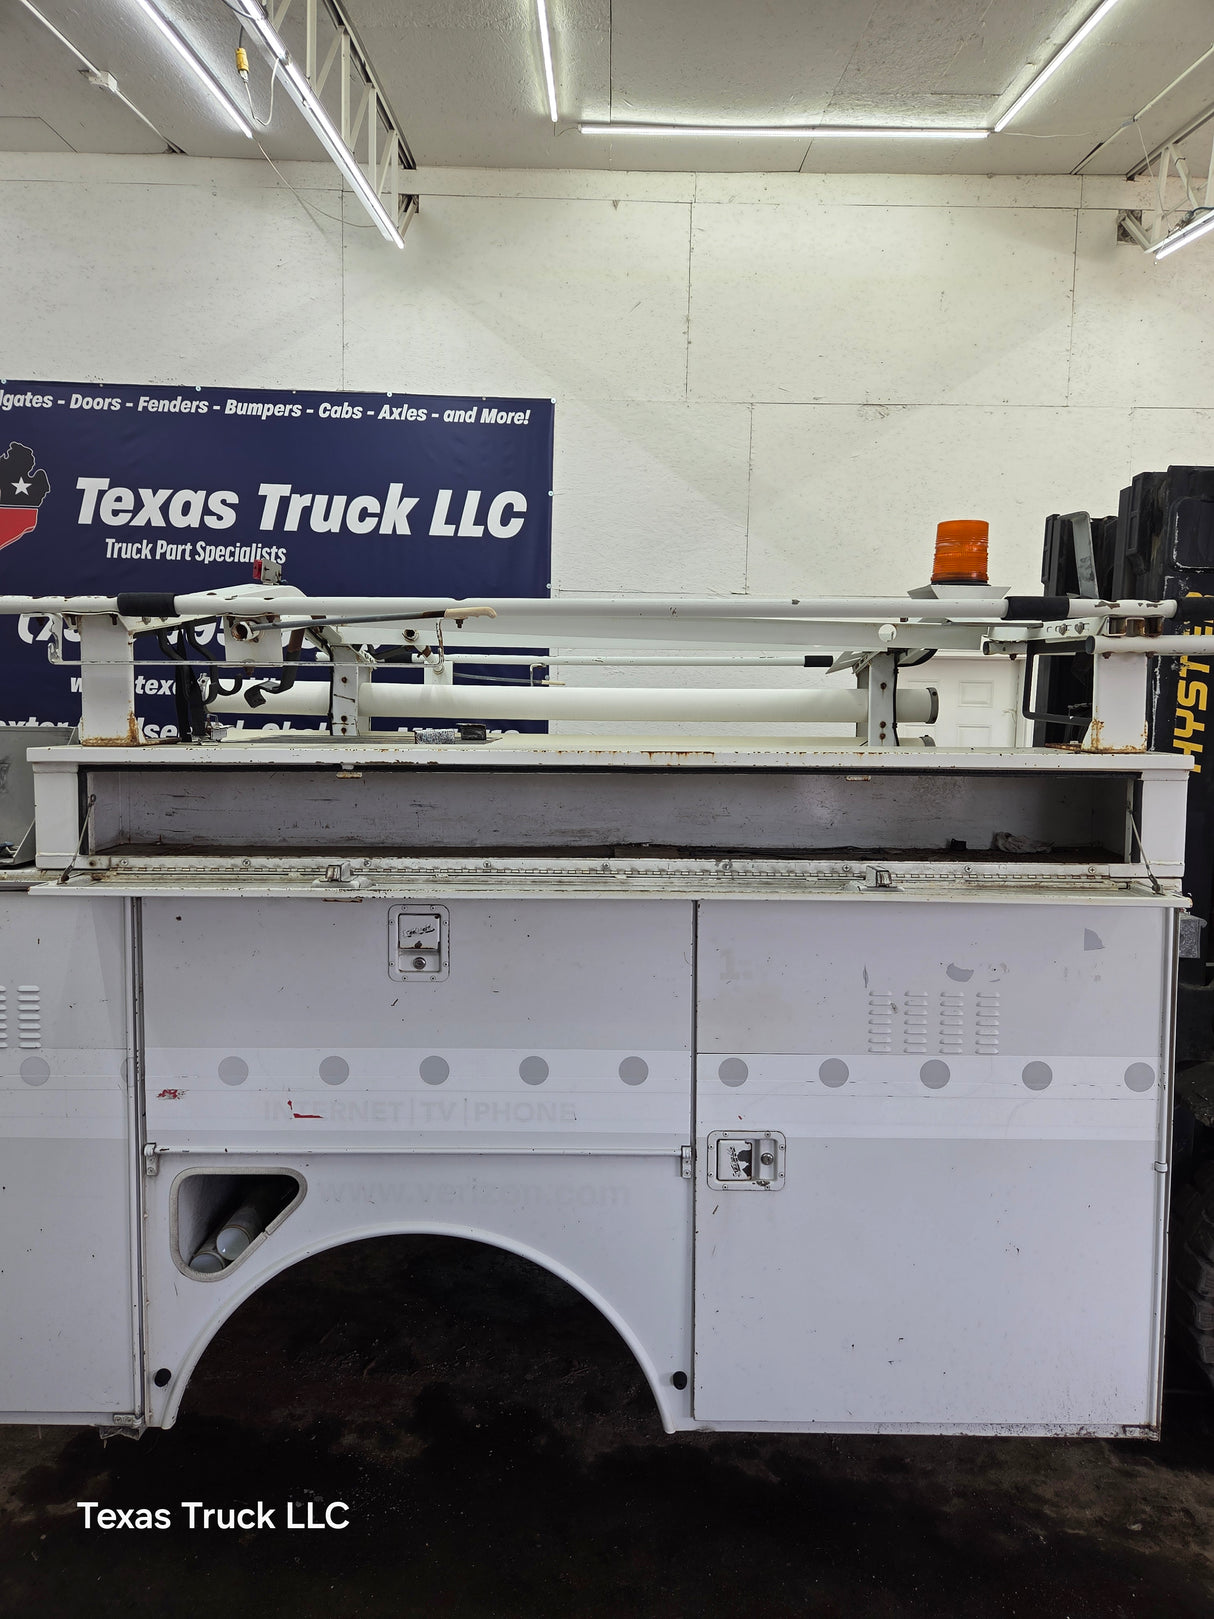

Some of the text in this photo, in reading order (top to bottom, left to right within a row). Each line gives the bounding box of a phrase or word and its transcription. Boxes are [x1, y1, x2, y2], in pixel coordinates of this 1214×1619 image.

[70, 394, 121, 410] Doors
[138, 396, 208, 413] Fenders
[225, 400, 302, 420] Bumpers
[319, 402, 363, 418] Cabs
[378, 404, 427, 421] Axles
[443, 407, 477, 423] and
[480, 408, 530, 424] More!
[76, 477, 527, 538] Texas Truck LLC
[106, 539, 287, 564] Truck Part Specialists
